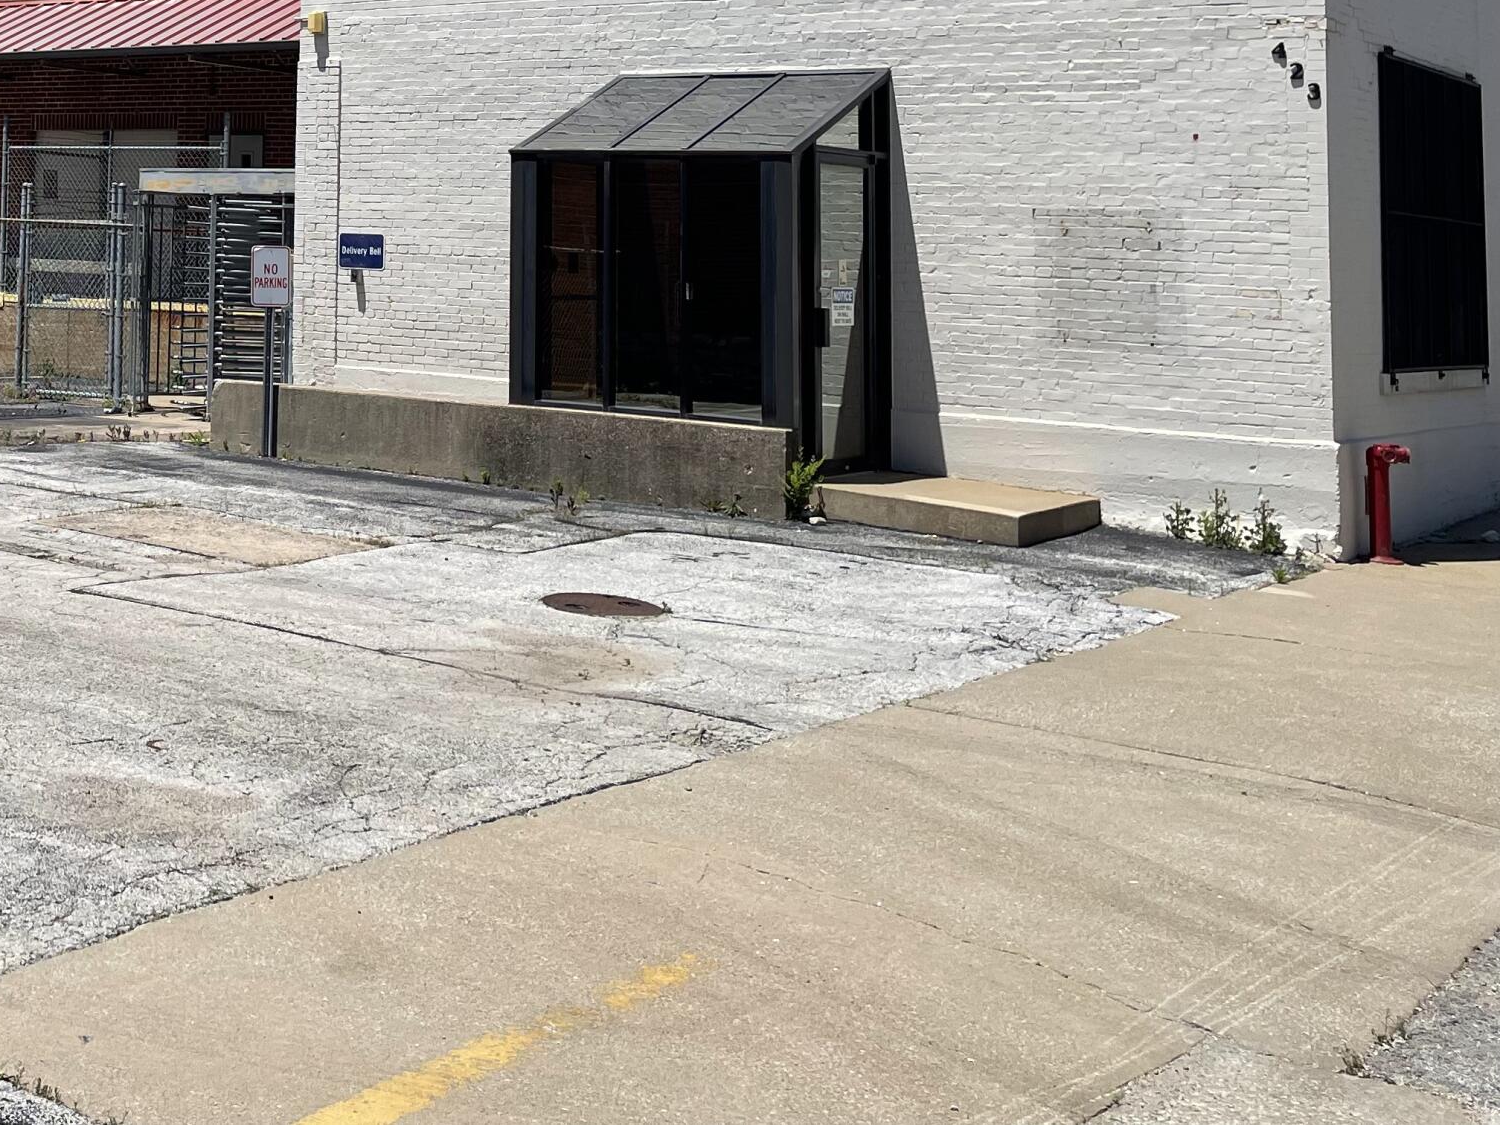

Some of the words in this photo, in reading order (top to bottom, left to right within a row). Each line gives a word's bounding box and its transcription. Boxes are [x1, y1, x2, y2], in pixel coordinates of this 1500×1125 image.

[1271, 42, 1320, 100] 423
[341, 245, 367, 257] Delivery
[369, 246, 382, 256] Bell
[263, 263, 278, 275] NO
[254, 277, 288, 289] PARKING
[833, 290, 853, 302] NOTICE
